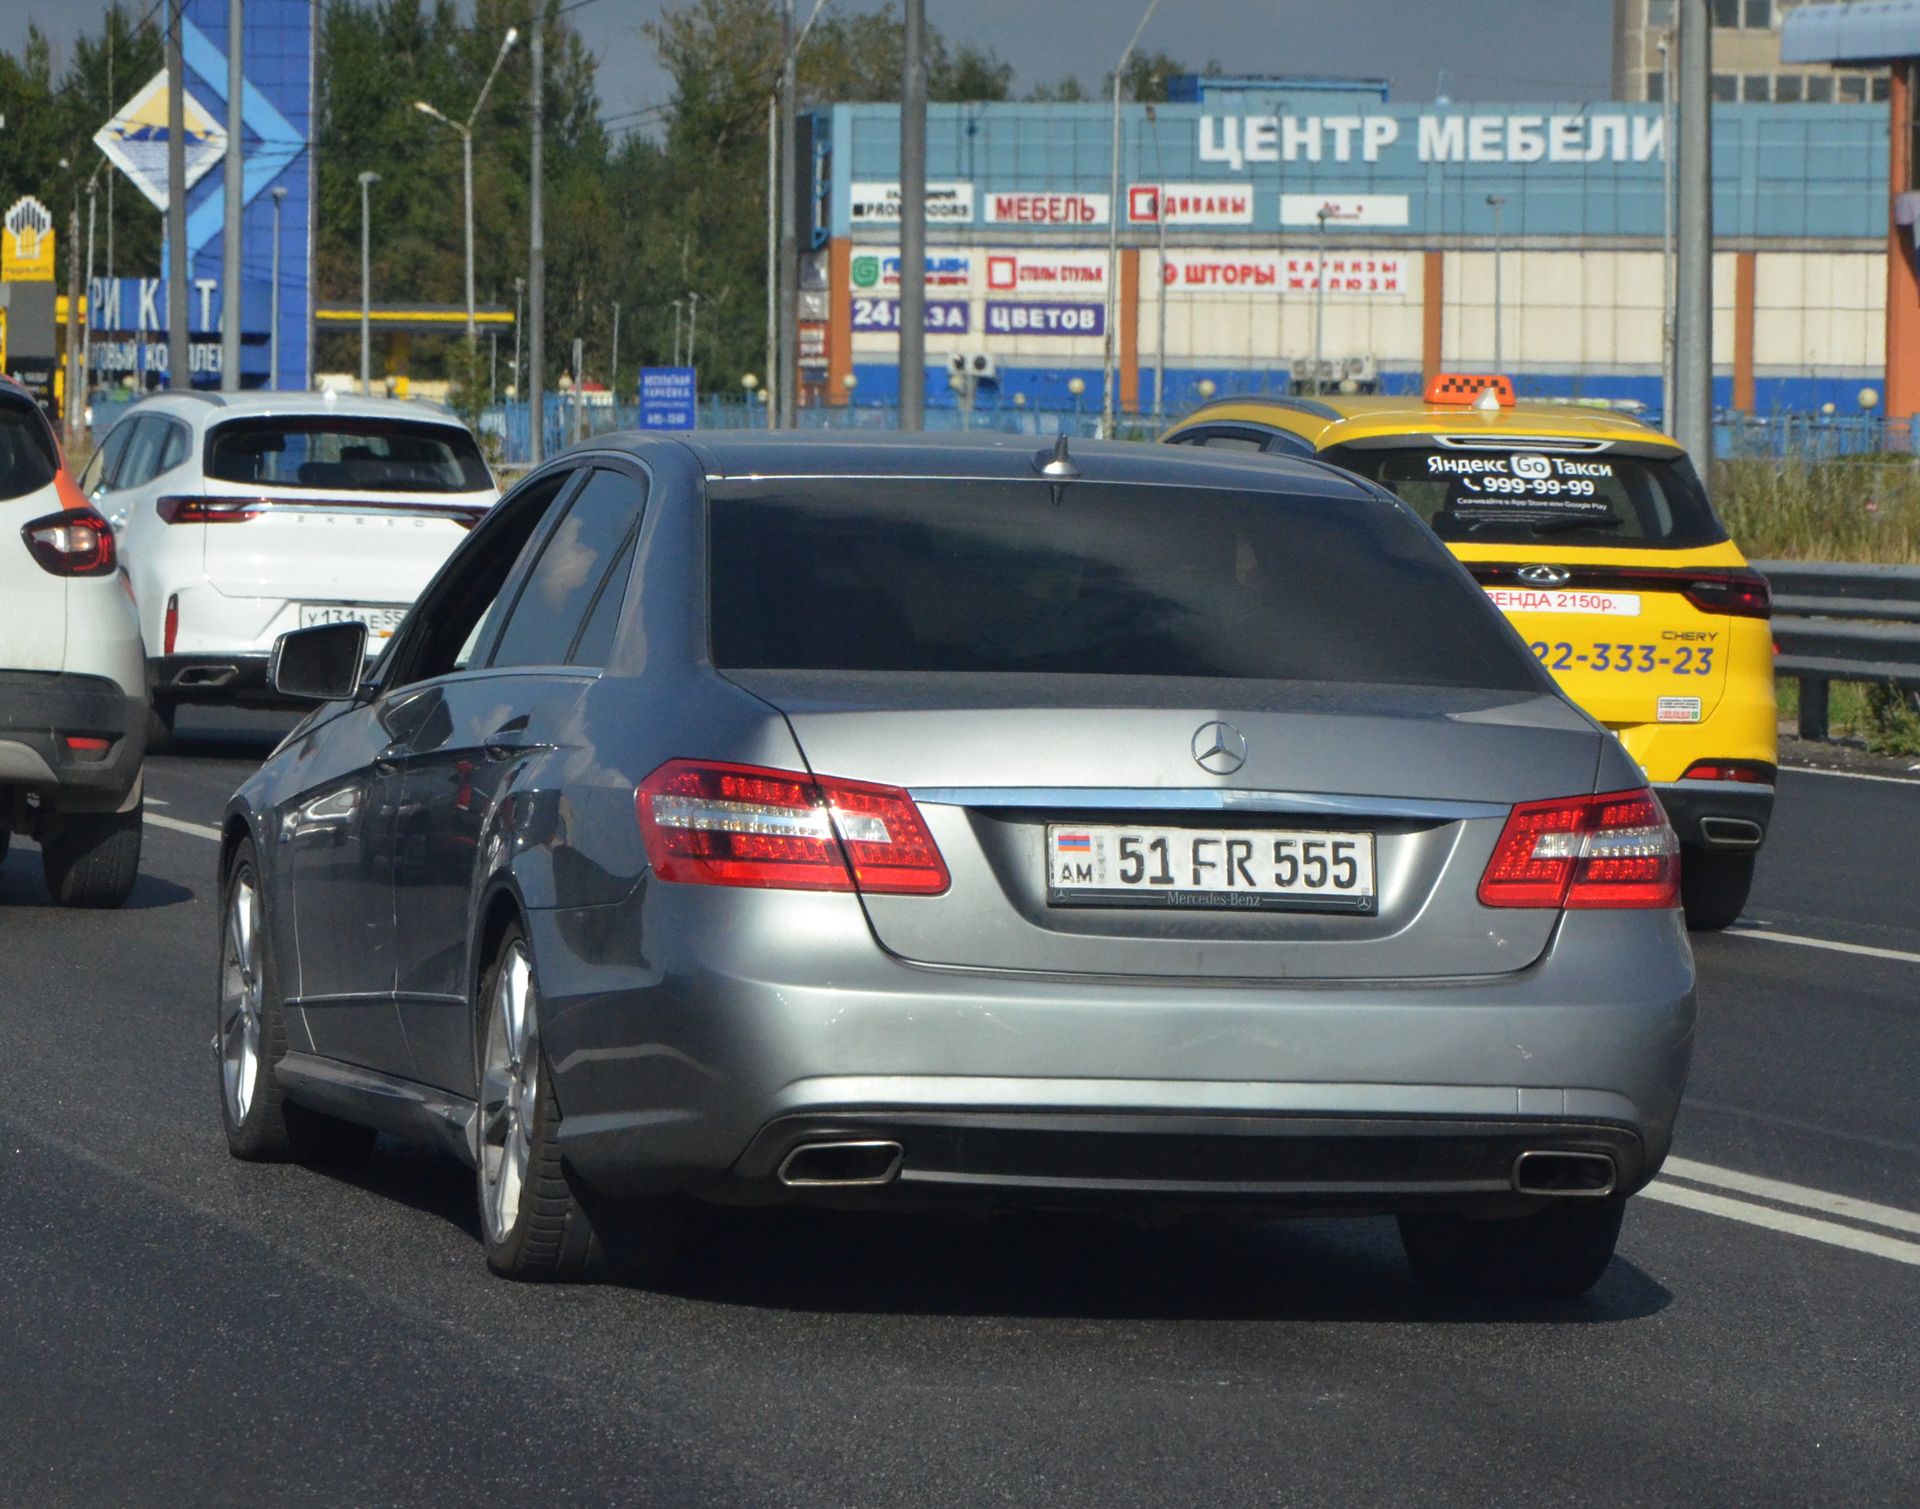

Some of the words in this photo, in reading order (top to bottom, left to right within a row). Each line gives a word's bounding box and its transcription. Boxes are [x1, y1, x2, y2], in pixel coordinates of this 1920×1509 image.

[1199, 115, 1398, 171] ЦЕНТР
[1417, 115, 1665, 164] МЕБЕЛИ
[995, 196, 1096, 223] МЕБЕЛЬ
[1164, 196, 1246, 215] ДИВАНЫ
[1184, 263, 1276, 285] ШТОРЫ
[1289, 277, 1397, 290] ЖАЛЮЗИ
[853, 301, 893, 326] 24
[990, 307, 1096, 331] ЦВЕТОВ
[1427, 455, 1509, 474] Яндекс
[1515, 456, 1548, 474] Go
[1551, 458, 1613, 477] Такси
[1482, 476, 1595, 496] 999-99-99
[1511, 499, 1527, 507] App
[1528, 499, 1549, 507] Store
[1565, 501, 1591, 510] Google
[1592, 503, 1608, 511] Play
[1557, 593, 1617, 612] 2150р.
[1661, 630, 1719, 642] CHERY
[1059, 862, 1093, 884] AM
[1118, 836, 1175, 886] 51
[1191, 837, 1257, 888] FR
[1273, 840, 1358, 889] 555
[1166, 890, 1262, 907] Mercedes-Benz
